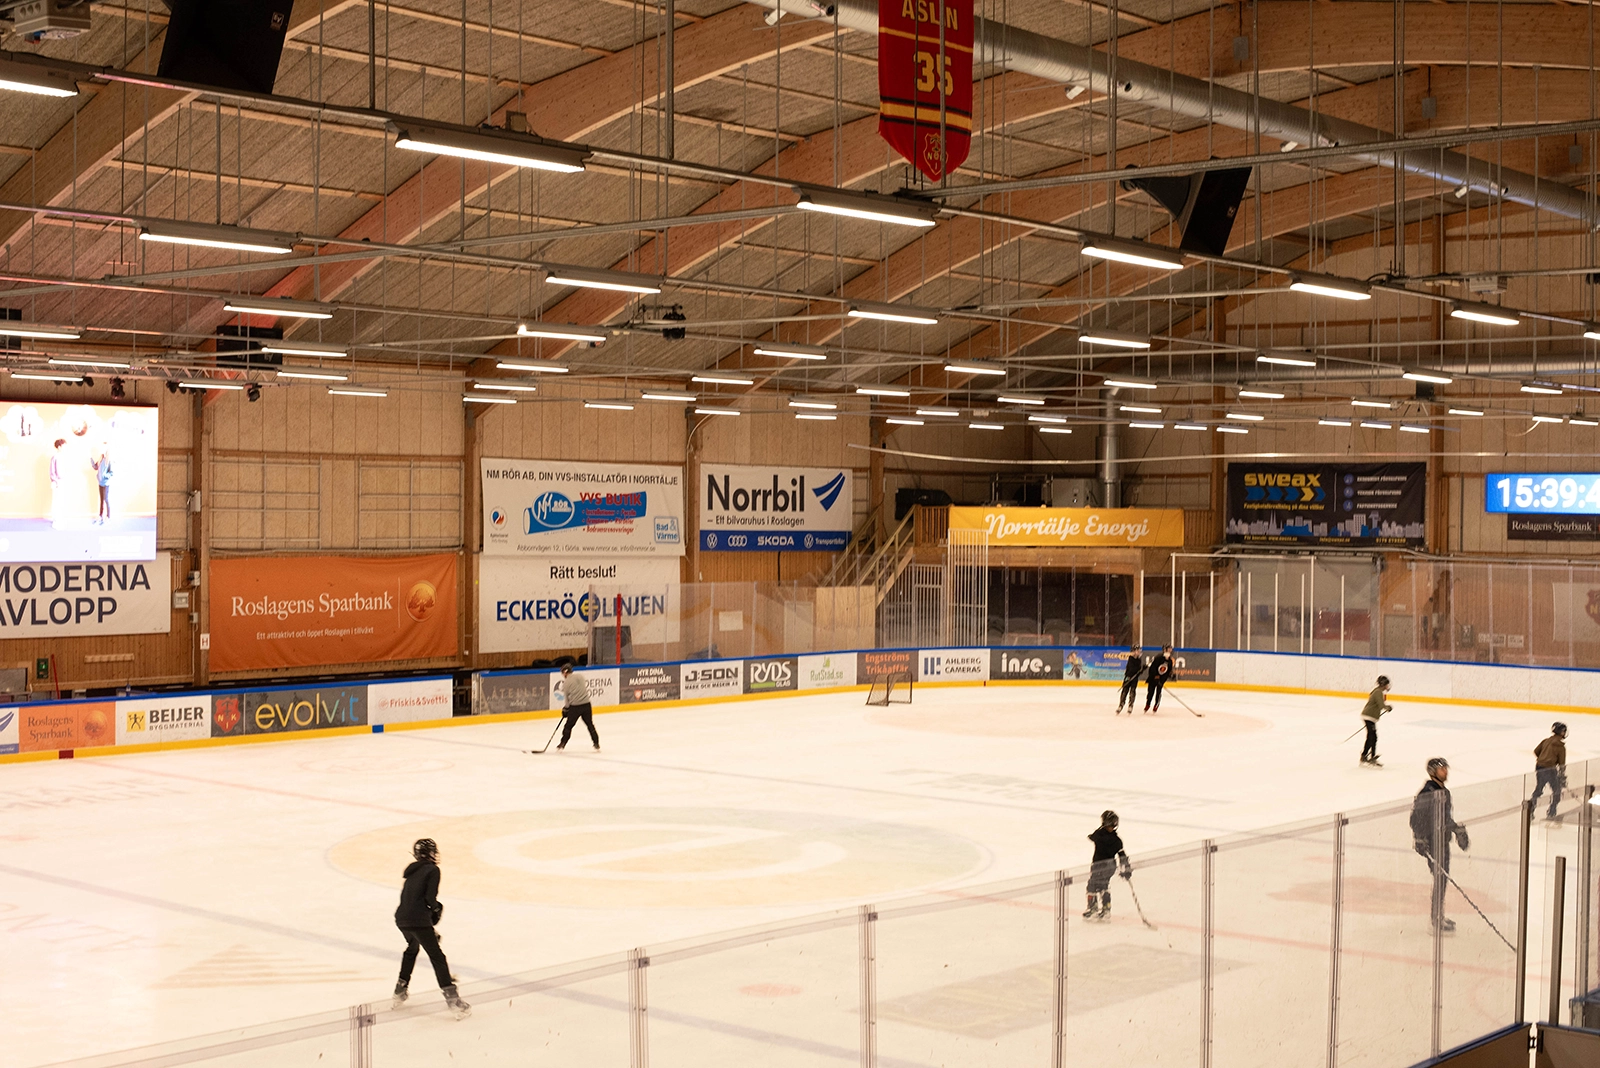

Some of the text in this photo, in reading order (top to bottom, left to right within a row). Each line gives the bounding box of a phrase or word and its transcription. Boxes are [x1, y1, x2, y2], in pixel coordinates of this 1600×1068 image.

[913, 51, 954, 96] 35
[486, 470, 500, 480] NM
[502, 469, 522, 480] RÖR
[522, 471, 536, 482] AB,
[538, 471, 553, 481] DIN
[556, 472, 628, 484] VVS-INSTALLATÖR
[633, 474, 678, 486] NORRTÄLJE
[1244, 472, 1321, 487] sweax
[580, 492, 642, 506] VVS BUTIK
[708, 474, 804, 512] Norrbil
[656, 523, 669, 531] Bad
[716, 515, 724, 525] Ett
[726, 516, 765, 526] bilvaruhus
[771, 516, 804, 528] Roslagen
[985, 513, 1150, 542] Norrtälje Energi
[1512, 520, 1592, 533] Roslagens Sparbank
[656, 532, 678, 540] Värme
[550, 565, 616, 580] Rätt beslut!
[231, 591, 394, 620] Roslagens Sparbank
[496, 593, 576, 622] ECKERÖ
[256, 632, 266, 640] Ett
[267, 630, 294, 639] attraktivt
[307, 629, 324, 639] öppet
[324, 628, 350, 638] Roslagen
[354, 626, 374, 635] tillväxt
[865, 652, 910, 664] Engströms
[1001, 652, 1051, 673] inse.
[637, 667, 664, 677] HYR DINA
[750, 660, 792, 683] RYDS
[585, 678, 612, 688] DERNA
[629, 677, 657, 686] MASKINER
[390, 696, 448, 708] Friskis&Svettis
[149, 706, 204, 723] BEIJER
[255, 692, 359, 730] evolvit
[28, 715, 73, 728] Roslagens
[149, 722, 204, 731] BYGGMATERIAL
[29, 728, 73, 742] Sparbank
